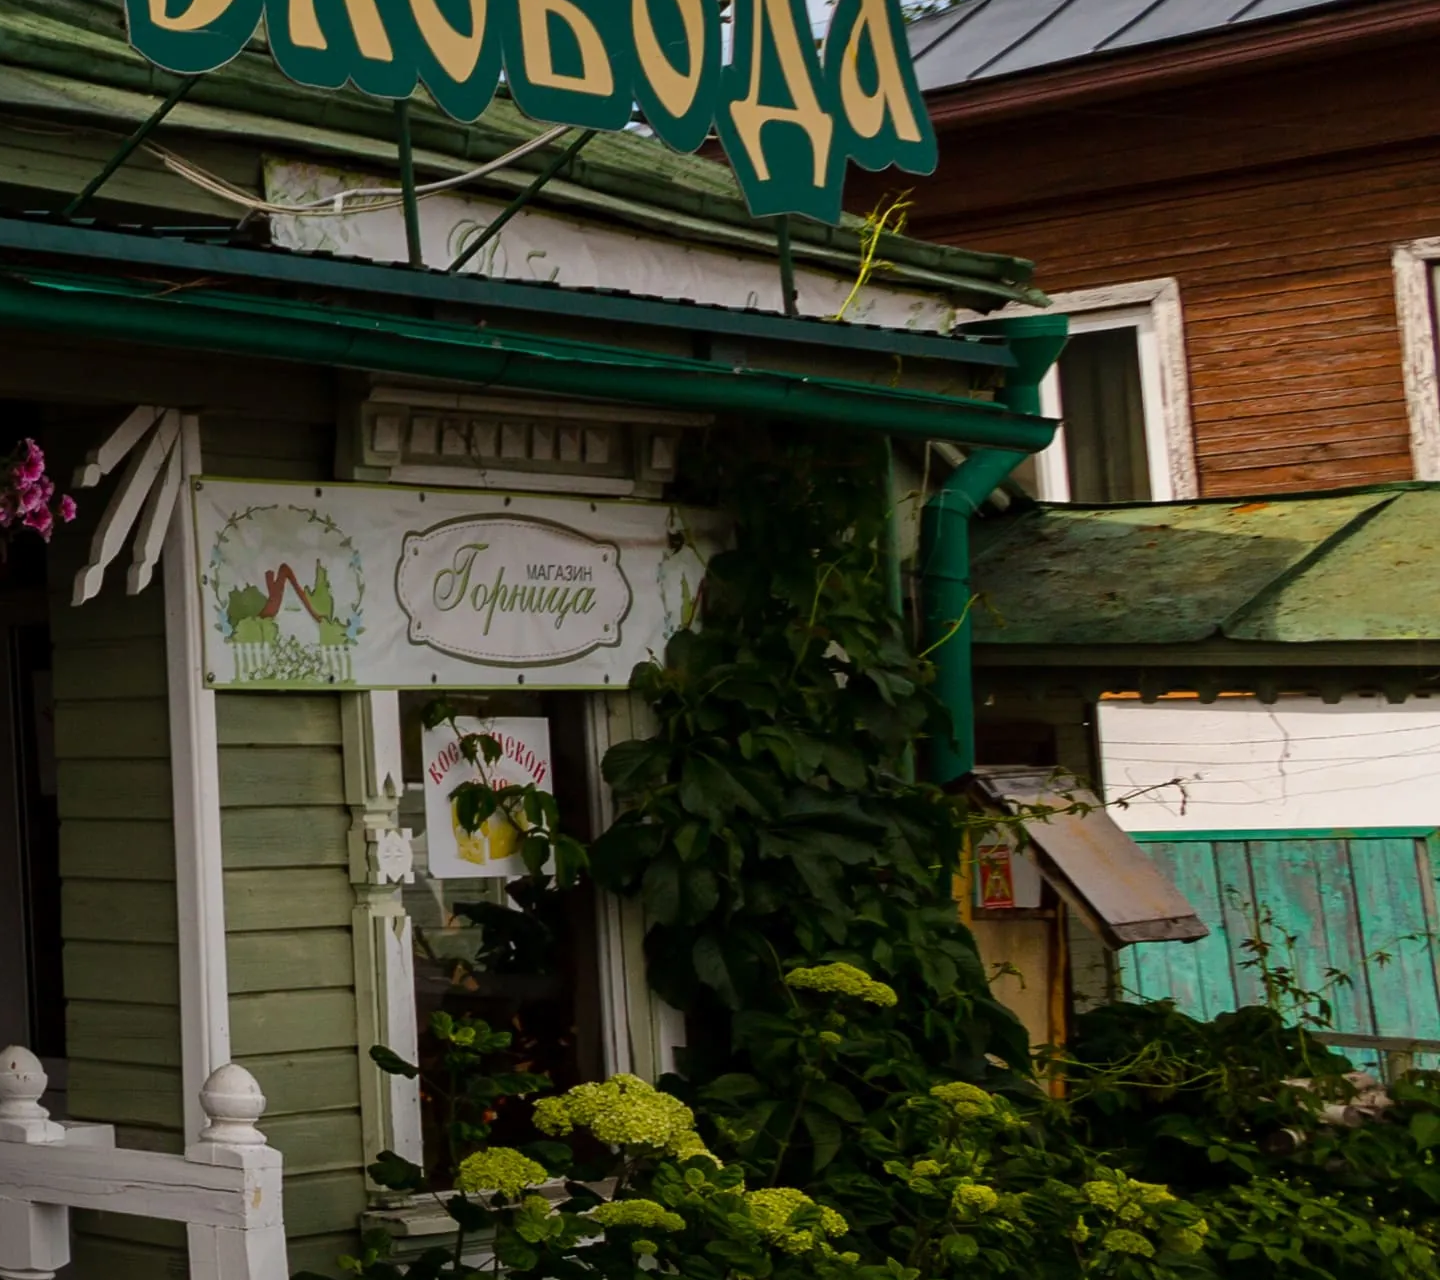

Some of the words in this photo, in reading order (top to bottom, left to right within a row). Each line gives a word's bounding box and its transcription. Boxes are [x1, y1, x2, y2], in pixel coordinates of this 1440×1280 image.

[433, 543, 596, 636] Горница
[526, 564, 592, 581] МАГАЗИН
[429, 731, 547, 785] КОССКОЙ
